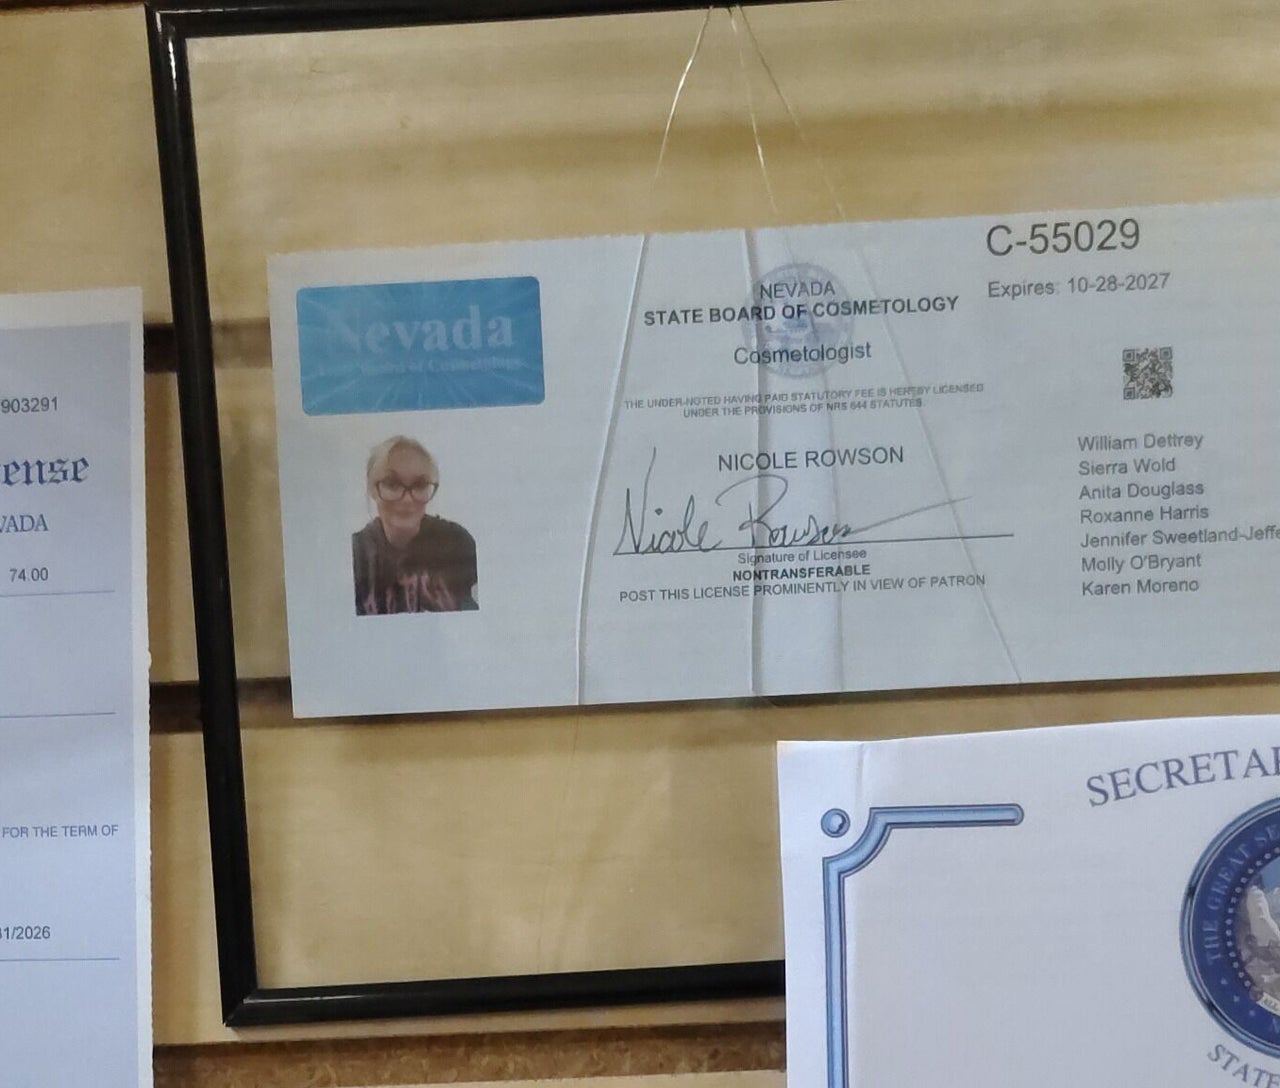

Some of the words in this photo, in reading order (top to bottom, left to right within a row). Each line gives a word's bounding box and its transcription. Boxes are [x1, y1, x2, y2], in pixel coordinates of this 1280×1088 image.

[986, 218, 1140, 257] C-55029
[759, 280, 837, 300] NEVADA
[1067, 271, 1171, 294] 10-28-2027
[644, 308, 704, 327] STATE
[709, 305, 776, 324] BOARD
[783, 303, 808, 320] OF
[812, 295, 960, 319] COSMETOLOGY
[733, 341, 873, 370] Cosmetologist
[0, 396, 58, 414] 903291
[1077, 435, 1138, 452] William
[1143, 432, 1205, 451] Dettrey
[718, 448, 798, 474] NICOLE
[805, 445, 904, 468] ROWSON
[1078, 460, 1128, 476] Sierra
[1133, 456, 1176, 474] Wold
[1078, 484, 1122, 500] Anita
[1127, 480, 1205, 500] Douglass
[1080, 508, 1154, 524] Roxanne
[1159, 504, 1210, 521] Harris
[1080, 530, 1149, 549] Jennifer
[738, 550, 796, 567] Signature
[798, 549, 810, 562] of
[813, 549, 867, 561] Licensee
[1081, 556, 1126, 575] Molly
[1129, 553, 1202, 573] O'Bryant
[9, 567, 49, 583] 74.00
[733, 564, 871, 582] NONTRANSFERABLE
[619, 589, 656, 603] POST
[659, 588, 690, 601] THIS
[693, 584, 750, 600] LICENSE
[753, 579, 850, 599] PROMINENTLY
[852, 579, 867, 592] IN
[870, 577, 905, 591] VIEW
[907, 576, 926, 589] OF
[930, 574, 986, 588] PATRON
[1082, 580, 1131, 596] Karen
[1136, 578, 1200, 594] Moreno
